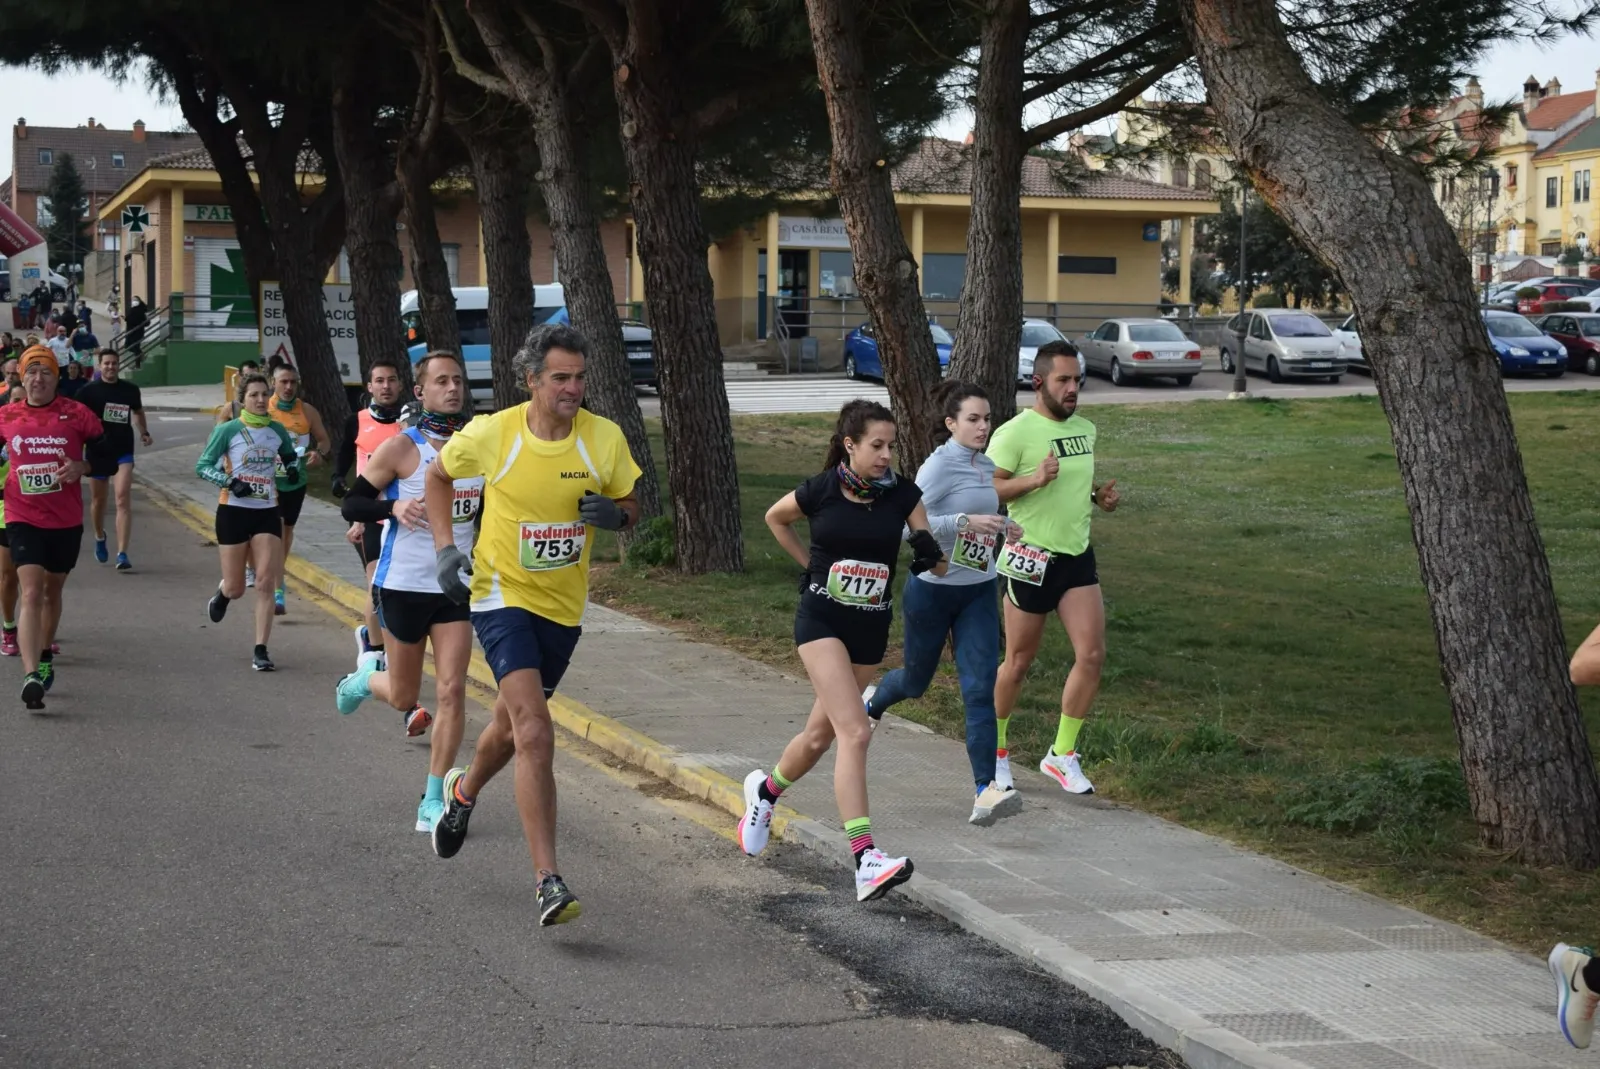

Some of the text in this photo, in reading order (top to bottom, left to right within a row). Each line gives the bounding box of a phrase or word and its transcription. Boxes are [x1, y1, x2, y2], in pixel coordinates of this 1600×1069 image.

[196, 206, 234, 219] FAR
[792, 225, 818, 234] CASA
[329, 328, 355, 338] DES
[108, 409, 123, 418] 784
[24, 435, 68, 447] apaches
[1061, 437, 1091, 456] RUN
[26, 474, 52, 487] 780
[238, 473, 271, 484] bedunia
[560, 471, 589, 479] MACIAS
[252, 482, 265, 494] 35
[454, 498, 471, 515] 18
[521, 525, 585, 540] bedunia
[533, 538, 574, 559] 753
[961, 540, 986, 561] 732
[1006, 551, 1037, 573] 733
[831, 563, 888, 579] bedunia
[840, 575, 876, 595] 717
